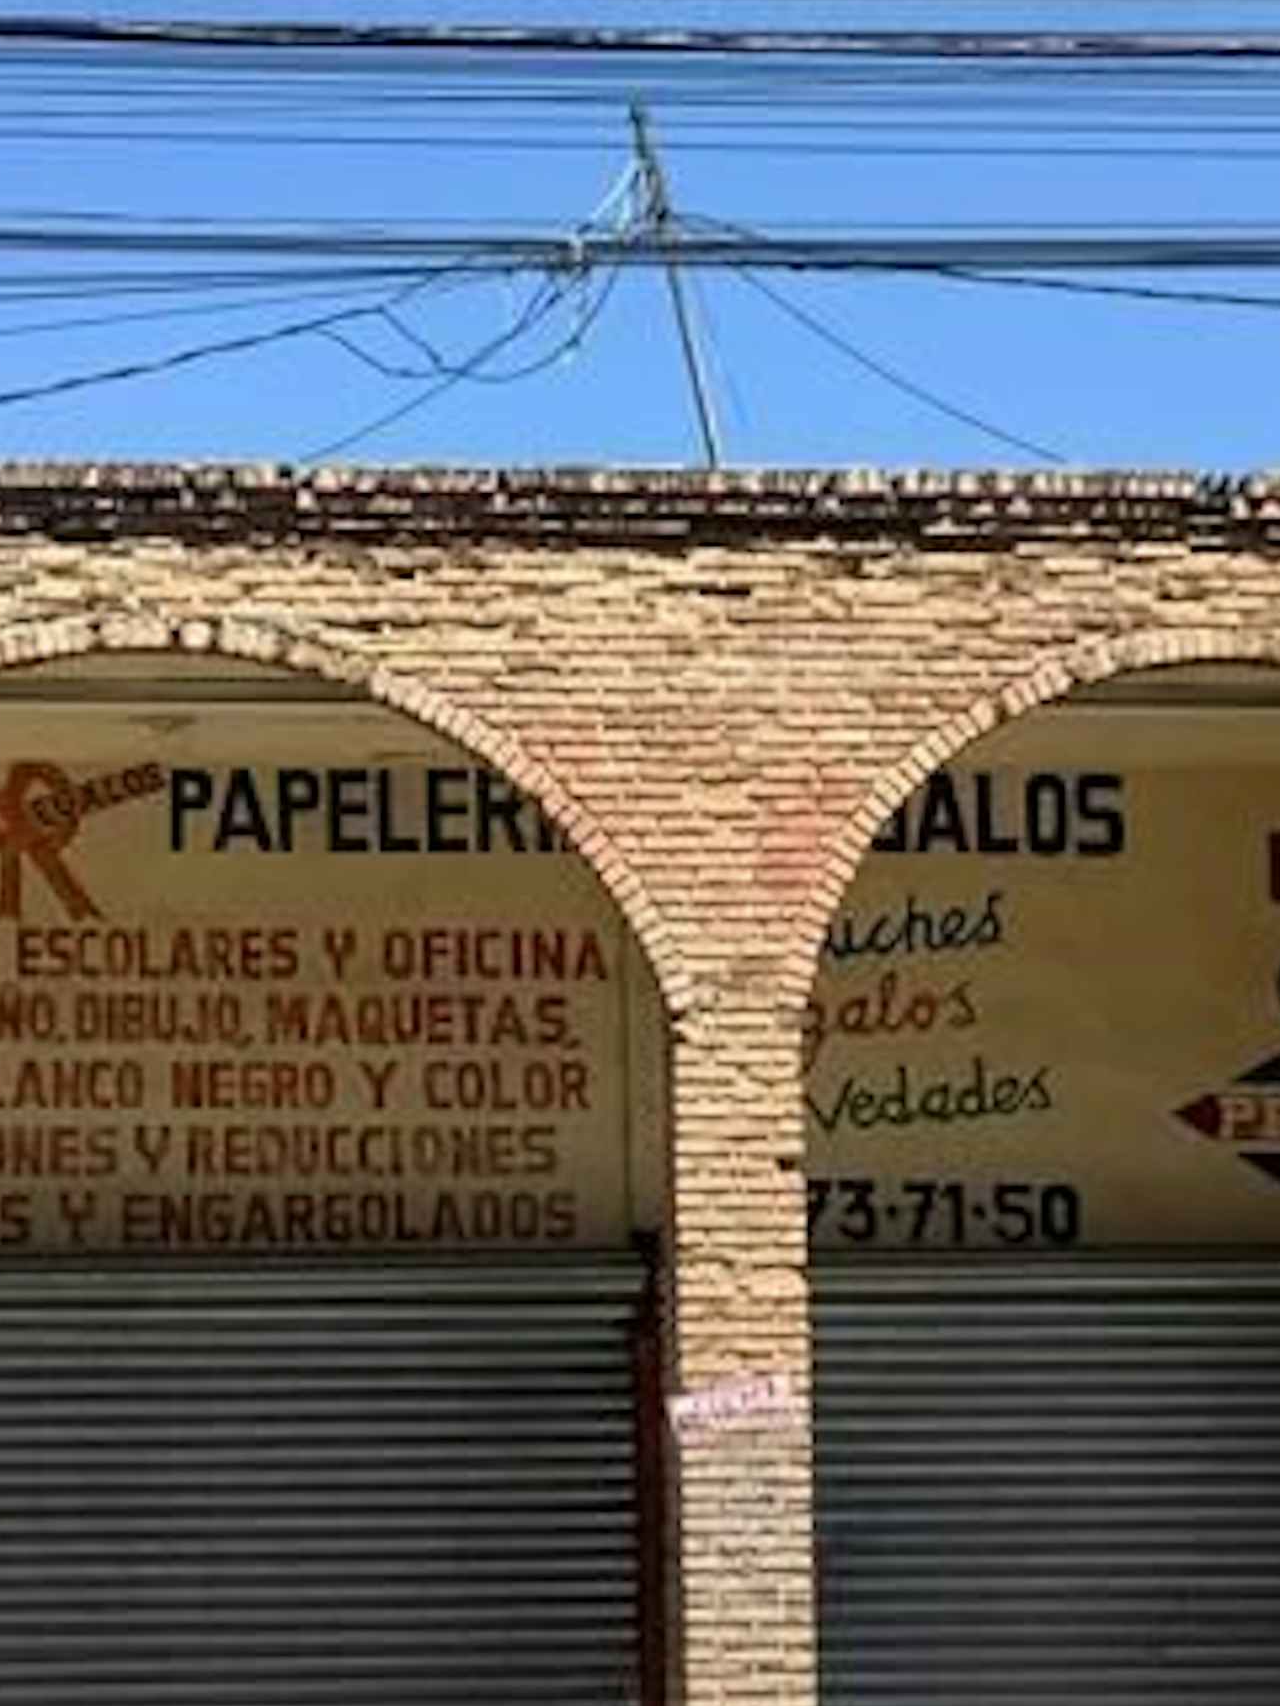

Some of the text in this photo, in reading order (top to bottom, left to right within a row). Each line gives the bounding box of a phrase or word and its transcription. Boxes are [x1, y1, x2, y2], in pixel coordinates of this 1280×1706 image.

[170, 768, 578, 853] PAPELERI
[17, 927, 298, 978] ESCOLARES
[319, 927, 356, 978] Y
[382, 929, 608, 981] OFICINA
[171, 1061, 333, 1109] NEGRO
[358, 1061, 400, 1109] Y
[423, 1060, 593, 1111] COLOR
[134, 1125, 171, 1175] Y
[186, 1125, 558, 1177] REDUCCIONES
[59, 1191, 95, 1246] Y
[124, 1190, 578, 1246] ENGARGOLADOS
